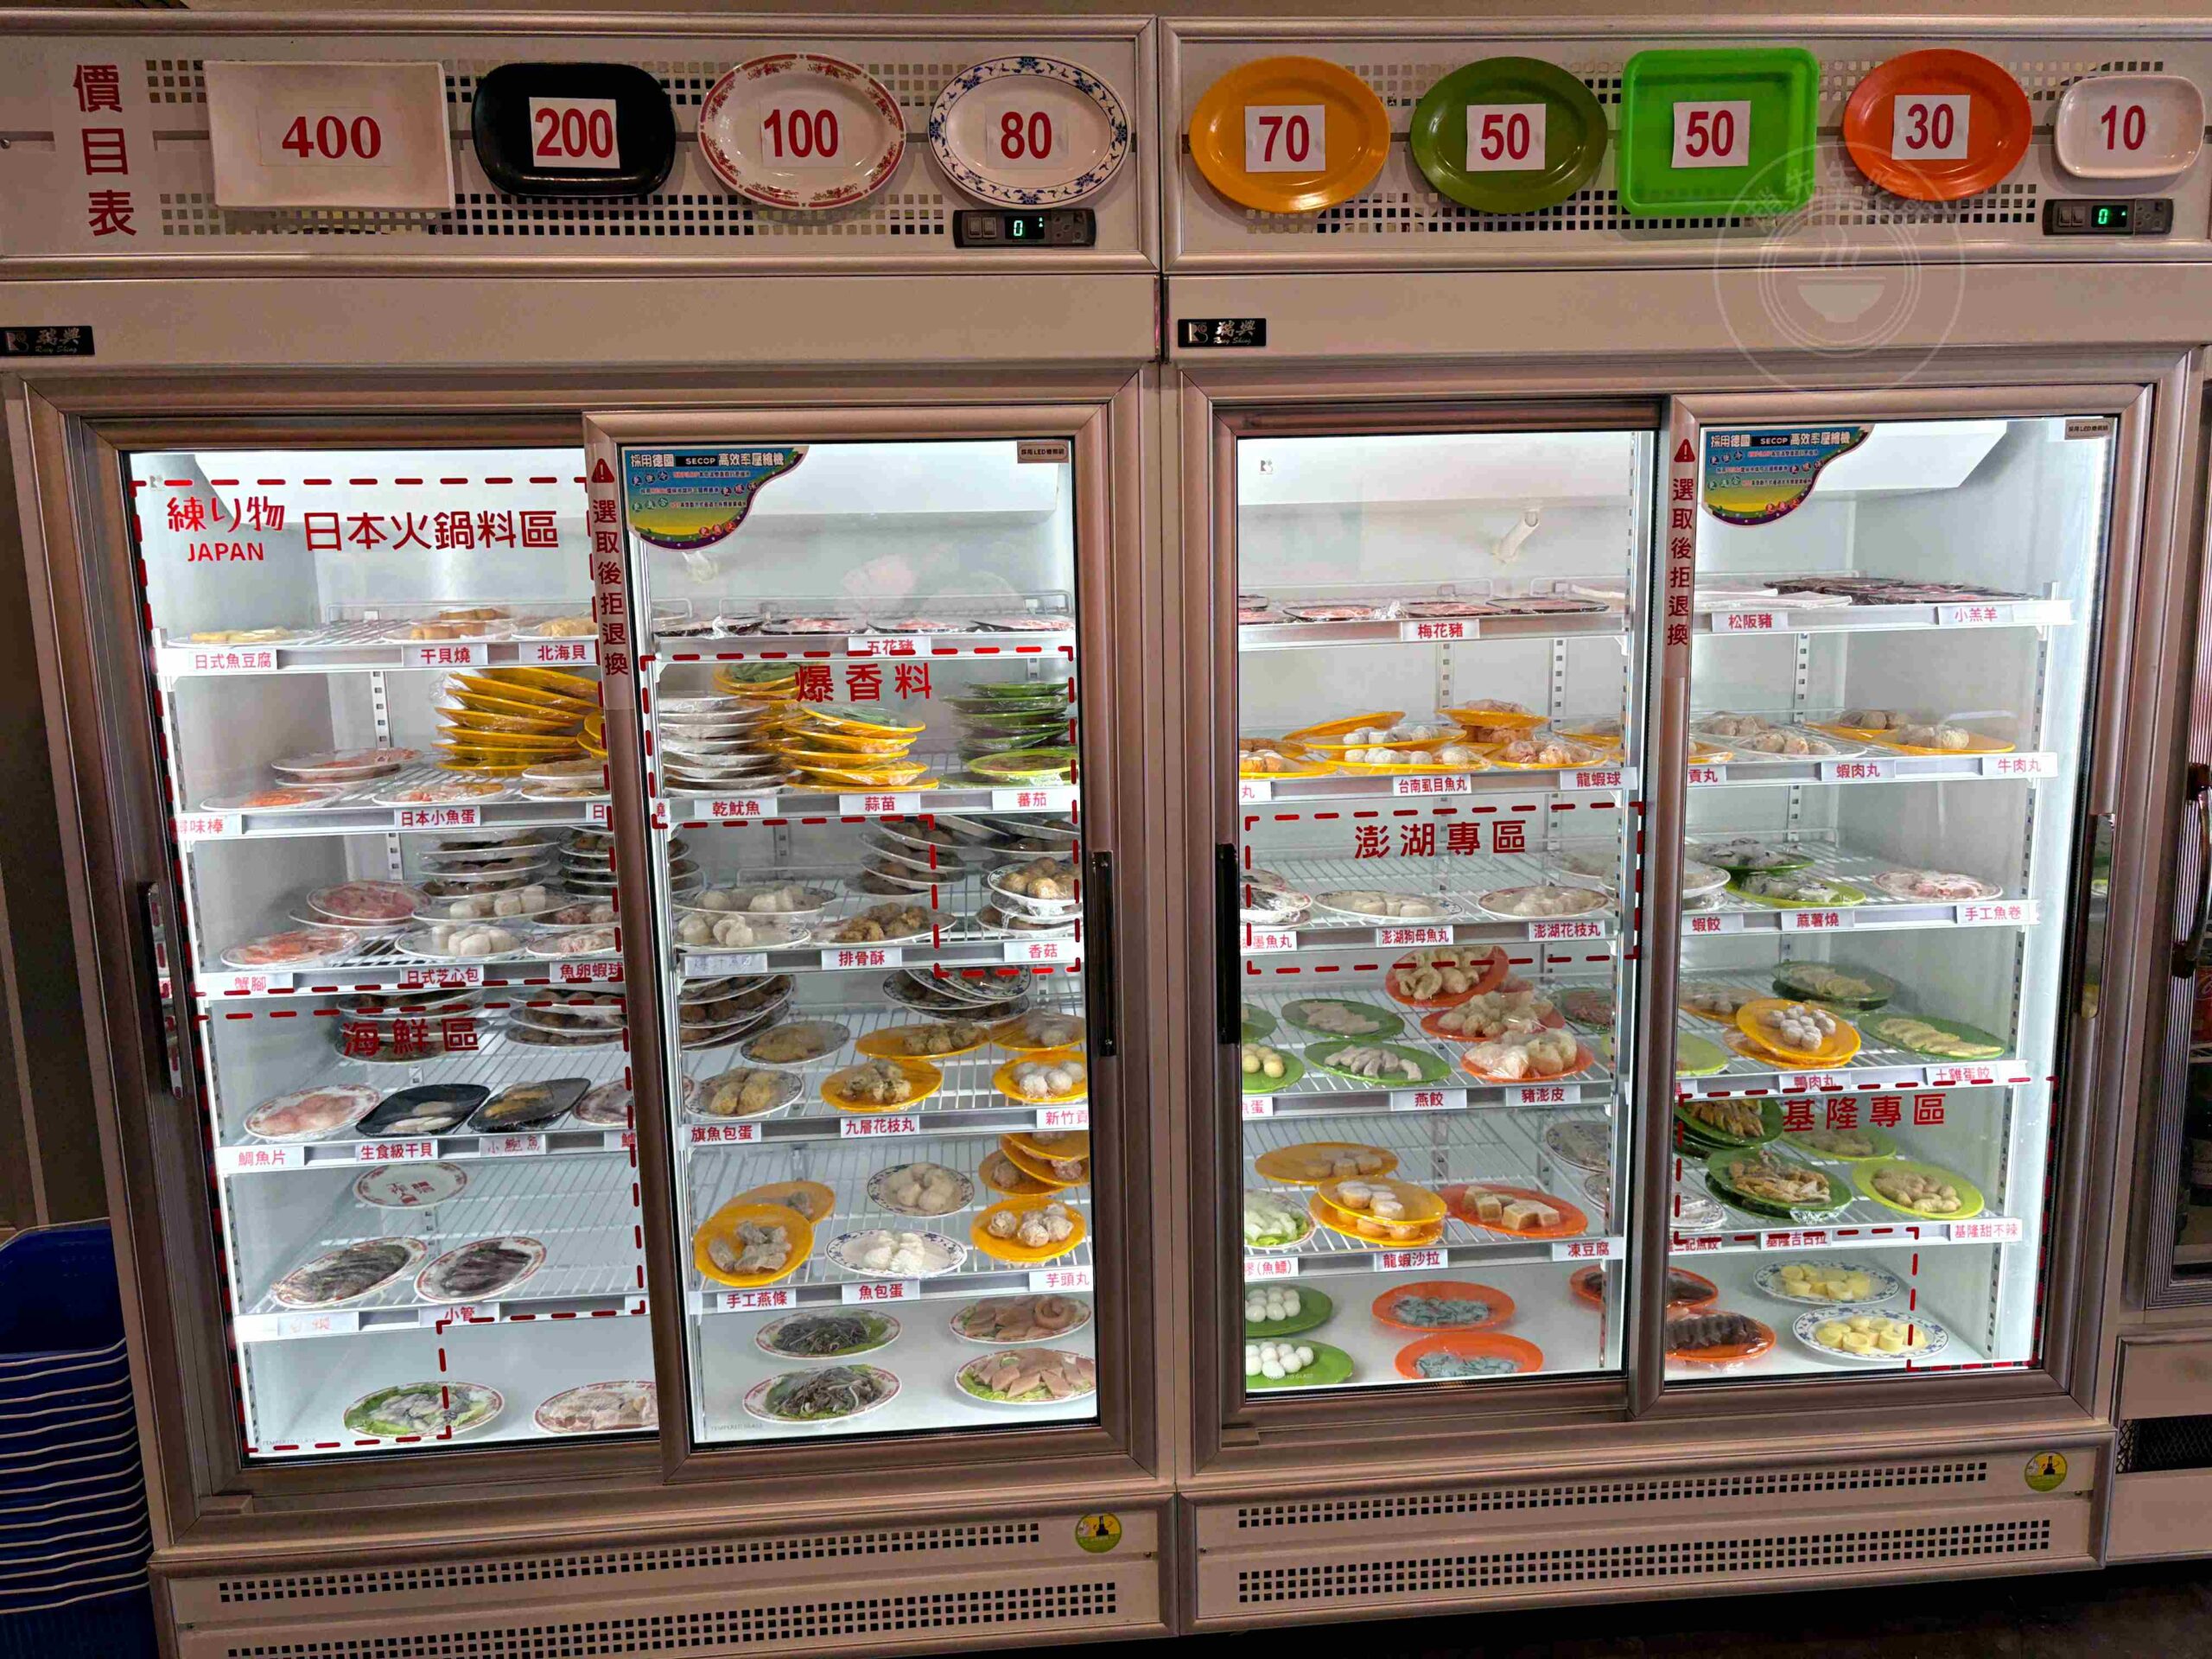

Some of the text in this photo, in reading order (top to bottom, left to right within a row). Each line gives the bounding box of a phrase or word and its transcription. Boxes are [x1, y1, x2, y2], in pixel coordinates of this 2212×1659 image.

[535, 107, 613, 157] 200
[764, 109, 838, 157] 100
[1686, 110, 1735, 158] 50
[1905, 103, 1954, 149] 30
[2101, 105, 2145, 150] 10
[282, 116, 381, 158] 400
[1001, 111, 1052, 159] 80
[1259, 115, 1309, 162] 70
[1480, 112, 1529, 160] 50
[73, 64, 137, 237] 價目表
[2098, 209, 2108, 225] 0
[1014, 219, 1023, 237] 0
[167, 495, 285, 532] 練り物
[304, 510, 559, 552] 日本火鍋料區
[188, 542, 265, 563] JAPAN
[1668, 478, 1694, 646] 選取後拒退換
[593, 499, 628, 676] 選取後拒退換
[1727, 613, 1773, 630] 松阪豬
[1955, 607, 1998, 623] 小羔羊
[1417, 622, 1463, 639] 梅花豬
[537, 645, 587, 660] 北海貝
[867, 639, 914, 655] 五花豬
[194, 652, 273, 670] 日式魚豆腐
[420, 649, 471, 664] 干貝燒
[794, 662, 932, 703] 爆香料
[1836, 763, 1880, 779] 蝦肉丸
[1998, 758, 2042, 773] 牛肉丸
[1575, 772, 1621, 787] 龍蝦球
[1688, 768, 1718, 783] 貢丸
[1398, 777, 1468, 794] 台南虱目魚丸
[712, 800, 760, 817] 乾魷魚
[864, 796, 896, 812] 蒜苗
[401, 809, 475, 827] 日本小魚蛋
[1354, 819, 1527, 859] 澎湖專區
[1964, 905, 2022, 922] 手工魚卷
[1382, 928, 1450, 945] 澎湖狗母魚丸
[1534, 922, 1601, 939] 澎湖花枝丸
[838, 950, 886, 967] 排骨酥
[1029, 943, 1058, 959] 香菇
[407, 968, 480, 985] 日式芝心包
[560, 962, 623, 979] 魚卵蝦球
[341, 1018, 480, 1058] 海鮮區
[1794, 1074, 1836, 1090] 鴨肉丸
[1414, 1091, 1444, 1107] 燕餃
[1783, 1093, 1946, 1133] 基隆專區
[690, 1124, 753, 1142] 旗魚包蛋
[846, 1117, 915, 1135] 九層花枝丸
[238, 1149, 286, 1166] 鯛魚片
[360, 1141, 433, 1160] 生食級干貝
[1955, 1223, 2019, 1239] 基隆甜不辣
[1567, 1242, 1610, 1257] 凍豆腐
[1383, 1251, 1440, 1269] 龍蝦沙拉
[1046, 1271, 1090, 1288] 芋頭丸
[858, 1283, 904, 1301] 魚包蛋
[444, 1306, 475, 1322] 小管
